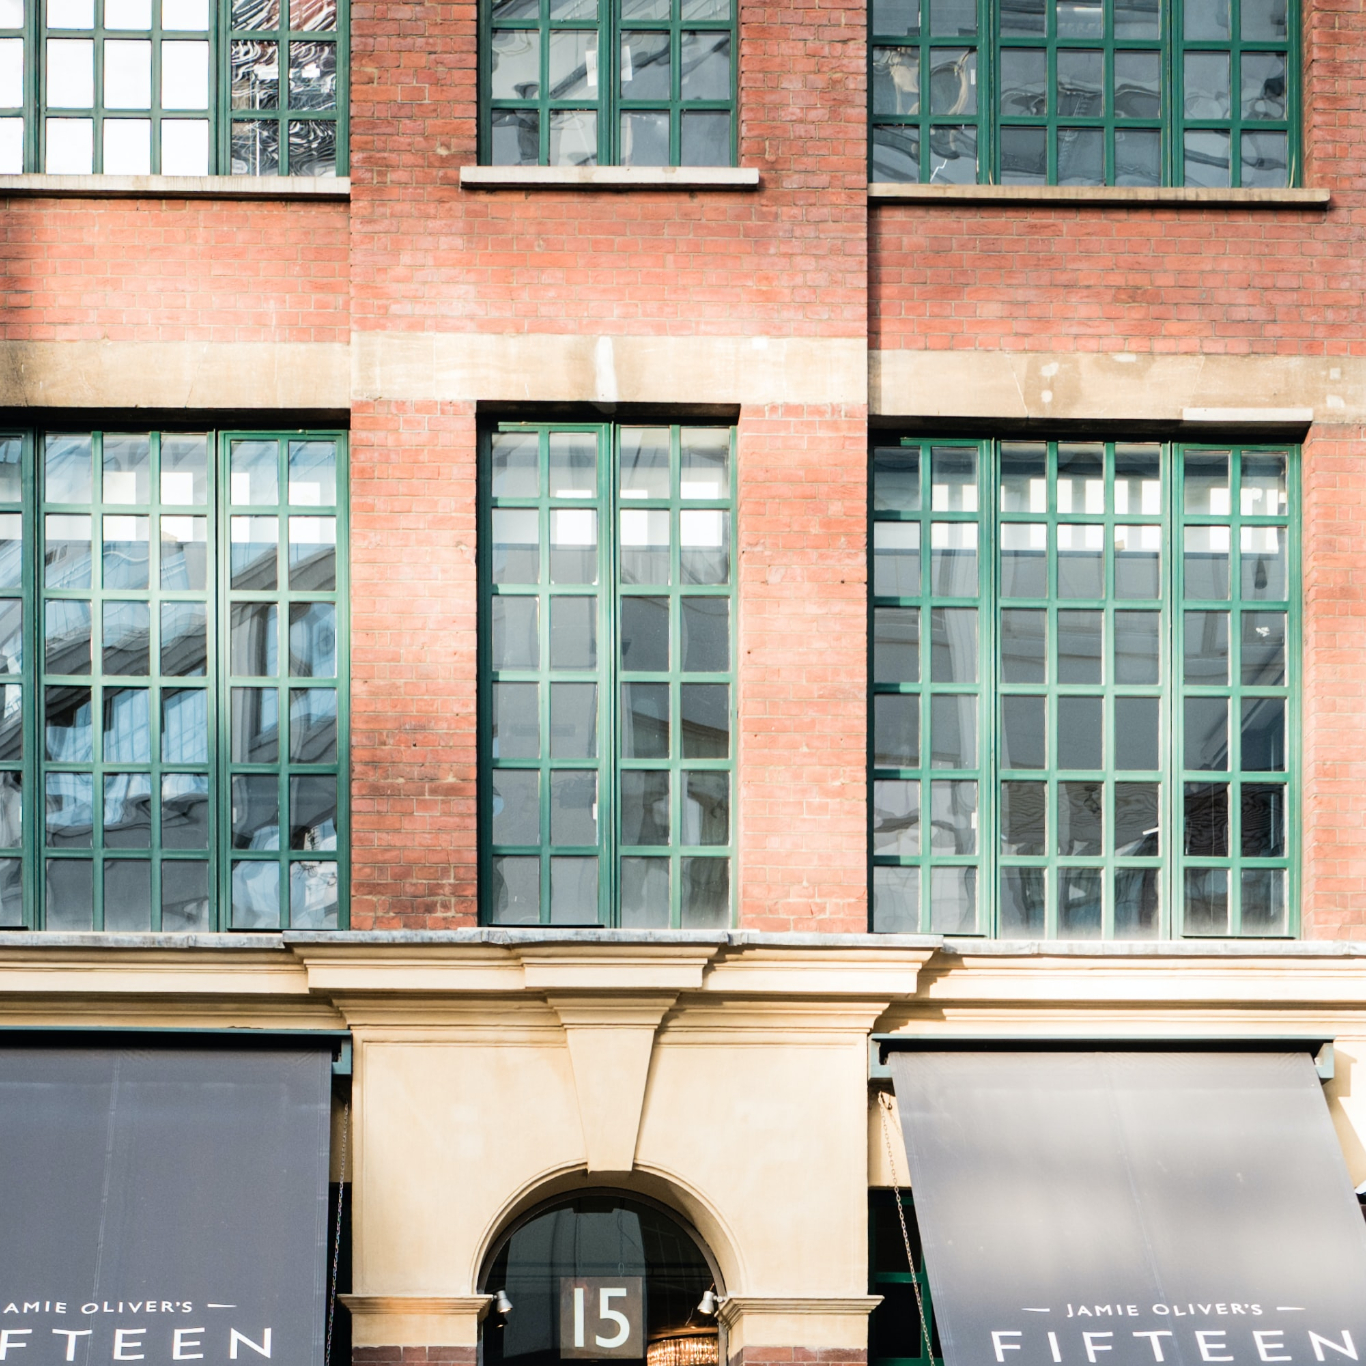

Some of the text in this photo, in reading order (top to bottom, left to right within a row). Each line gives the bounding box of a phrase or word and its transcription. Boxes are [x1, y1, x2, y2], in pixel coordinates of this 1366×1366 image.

[80, 1300, 193, 1315] OLIVER'S
[573, 1287, 631, 1349] 15
[1066, 1302, 1263, 1318] JAMIE OLIVER'S
[990, 1329, 1359, 1363] FIFTEEN
